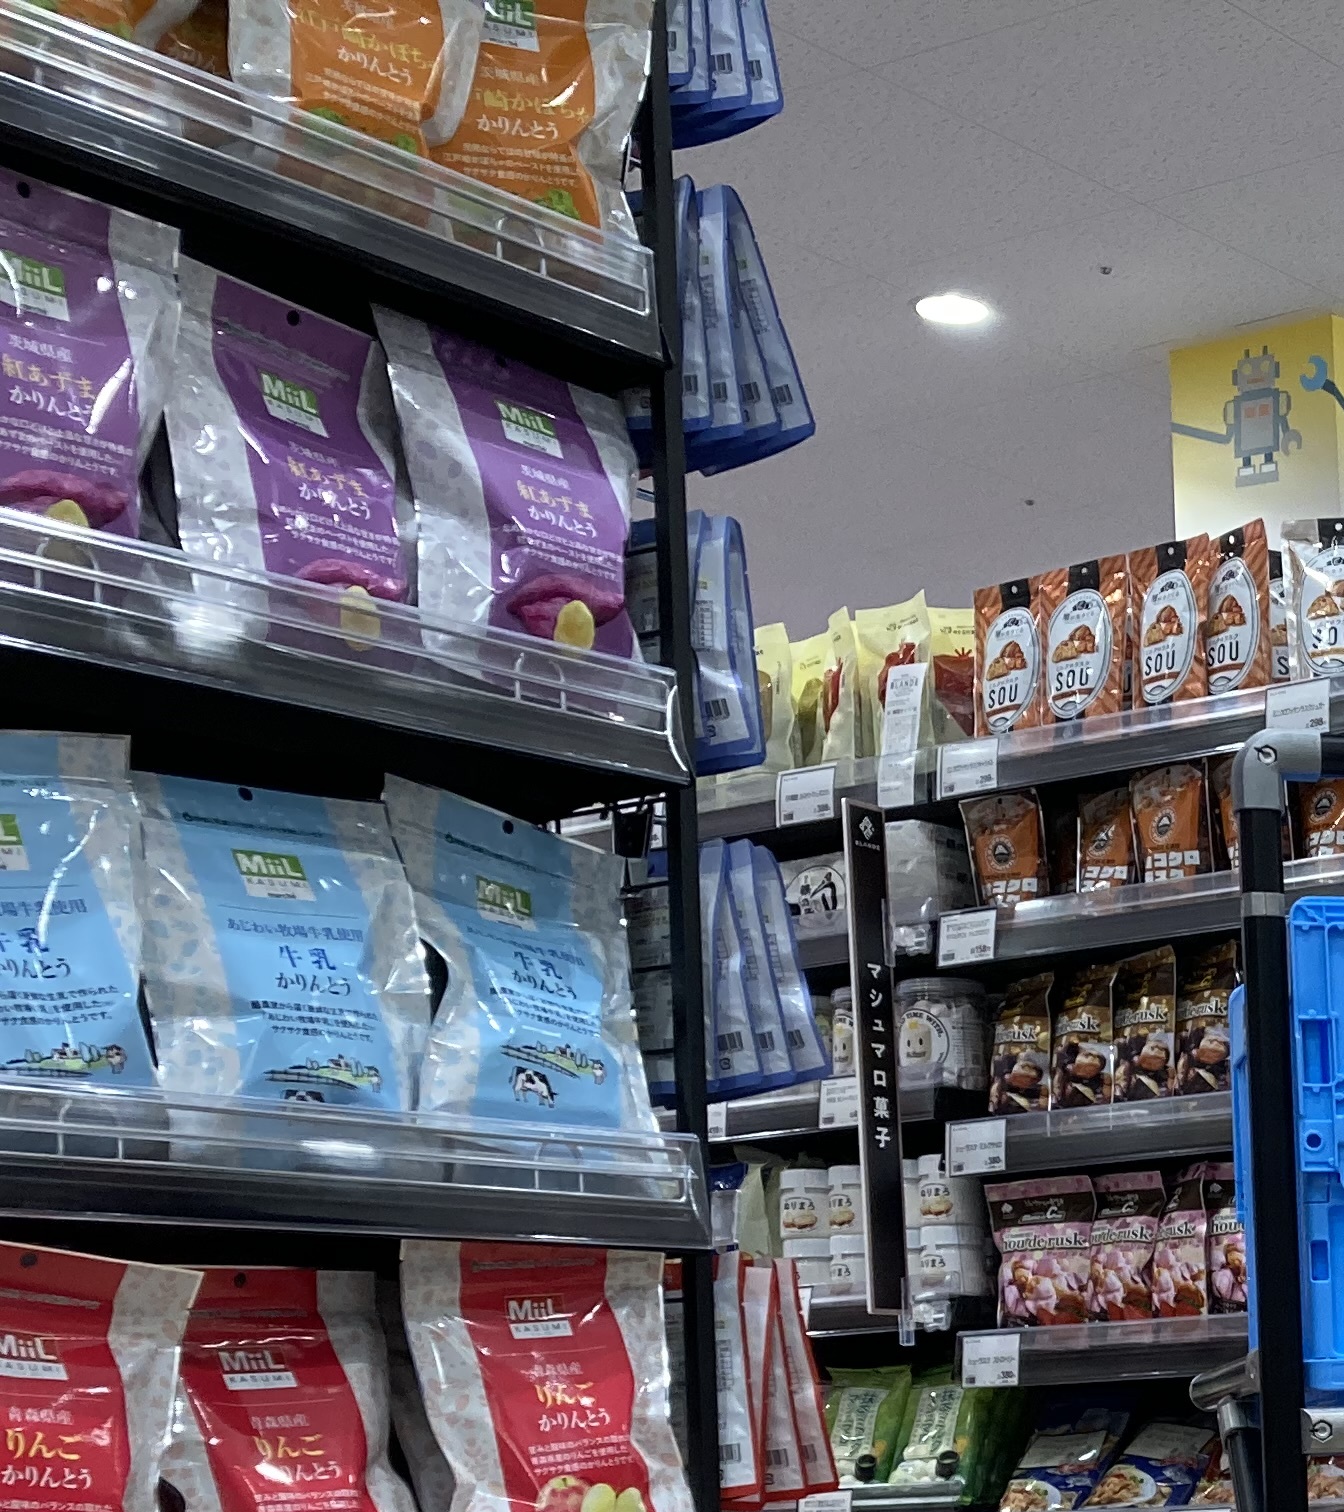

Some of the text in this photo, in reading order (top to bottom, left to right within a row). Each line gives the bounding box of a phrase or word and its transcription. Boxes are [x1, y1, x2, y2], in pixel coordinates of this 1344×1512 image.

[337, 46, 412, 87] かりんとう
[478, 114, 559, 140] かりんとう
[1, 354, 96, 400] 紅あずま
[260, 374, 317, 413] MiiL
[500, 402, 554, 437] MiiL
[516, 480, 594, 519] 紅あずま
[527, 505, 597, 538] かりんとう
[1144, 651, 1175, 676] SOU
[1207, 640, 1239, 667] SOU
[1056, 669, 1089, 693] SOU
[988, 683, 1018, 709] SOU
[236, 853, 304, 880] MiiL
[279, 946, 336, 971] 牛乳
[514, 951, 562, 979] 牛乳
[275, 973, 351, 997] かりんとう
[512, 970, 577, 1000] かりんとう
[866, 963, 892, 1149] マシュマロ菓子
[1047, 1232, 1084, 1249] rusk
[1120, 1227, 1153, 1242] rusk
[508, 1298, 557, 1321] MiiL
[218, 1351, 286, 1372] MiiL
[535, 1382, 595, 1408] りんご
[538, 1408, 611, 1433] かりんとう
[5, 1427, 82, 1461] りんご
[253, 1433, 326, 1459] りんご
[1, 1464, 92, 1489] かりんとう
[256, 1460, 341, 1485] りんとう
